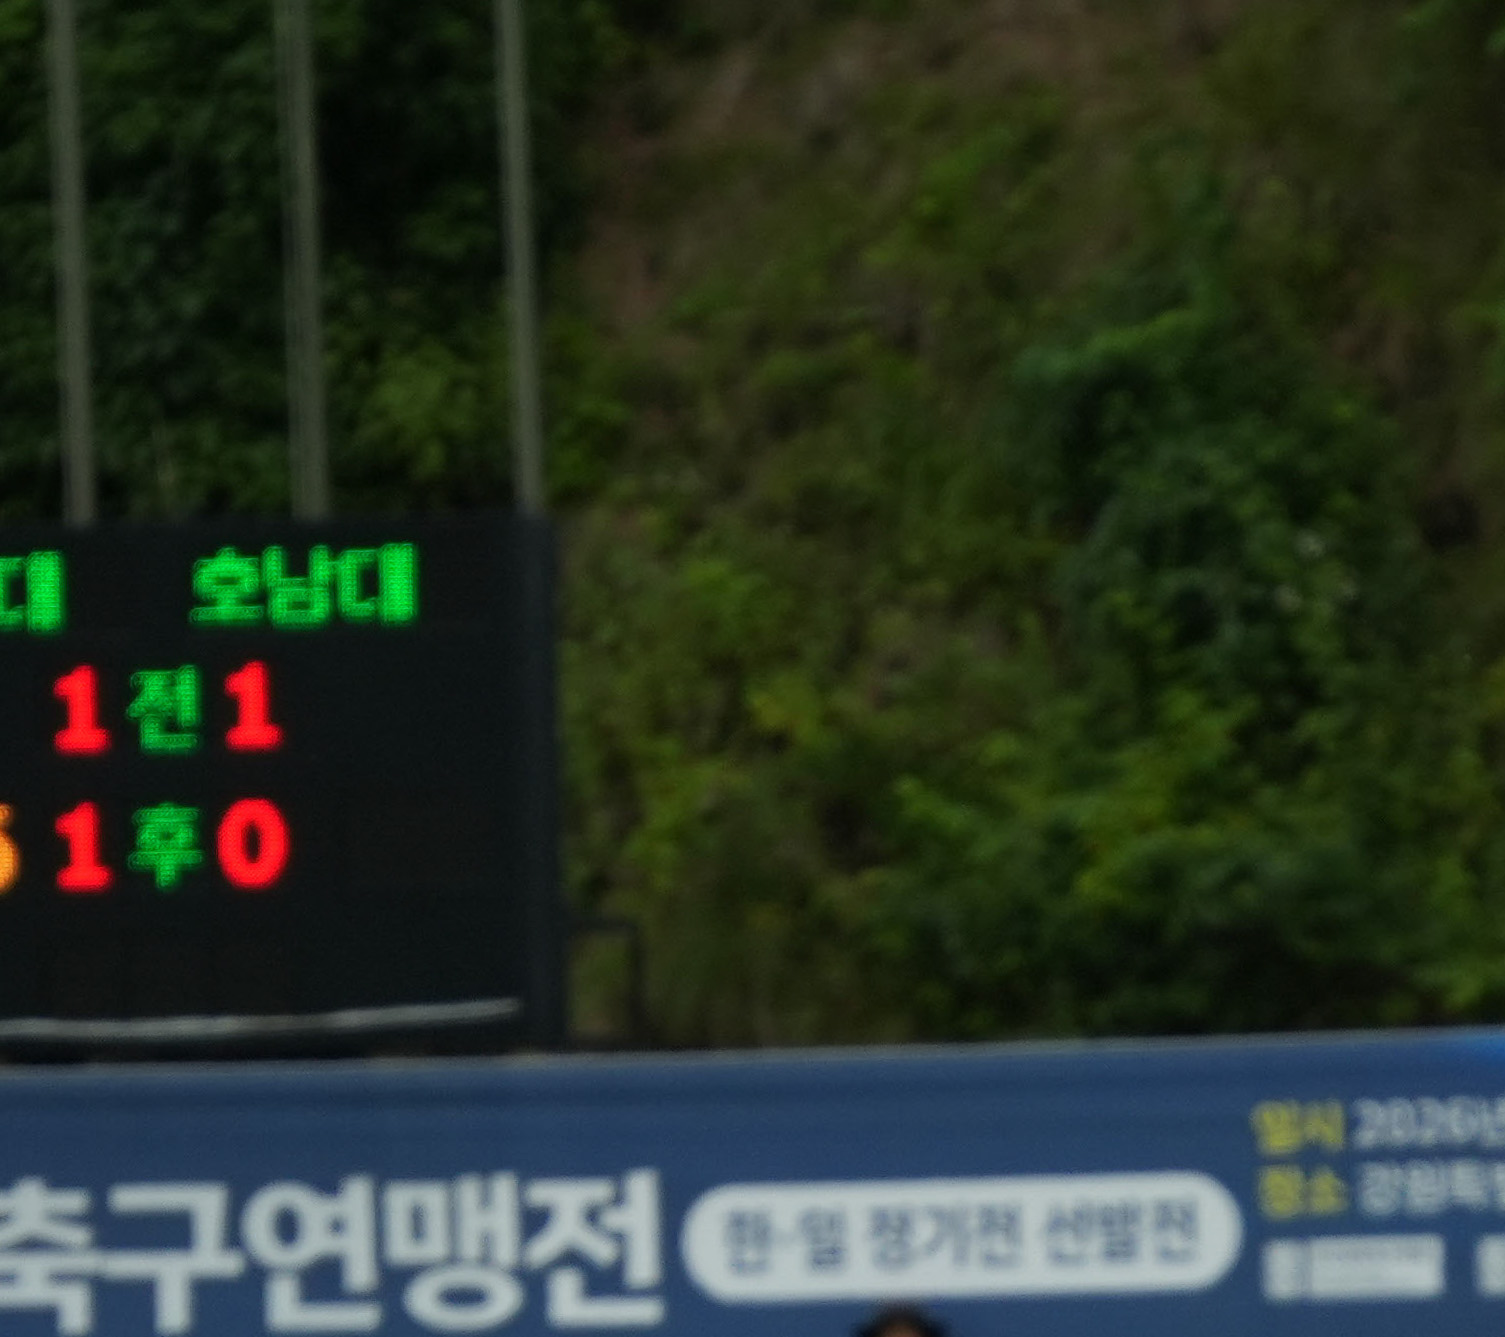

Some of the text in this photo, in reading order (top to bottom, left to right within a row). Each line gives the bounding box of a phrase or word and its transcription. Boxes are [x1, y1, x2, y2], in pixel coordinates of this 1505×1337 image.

[189, 542, 420, 628] 호남대
[52, 659, 284, 757] 1 전 1
[54, 797, 291, 894] 1 후 0
